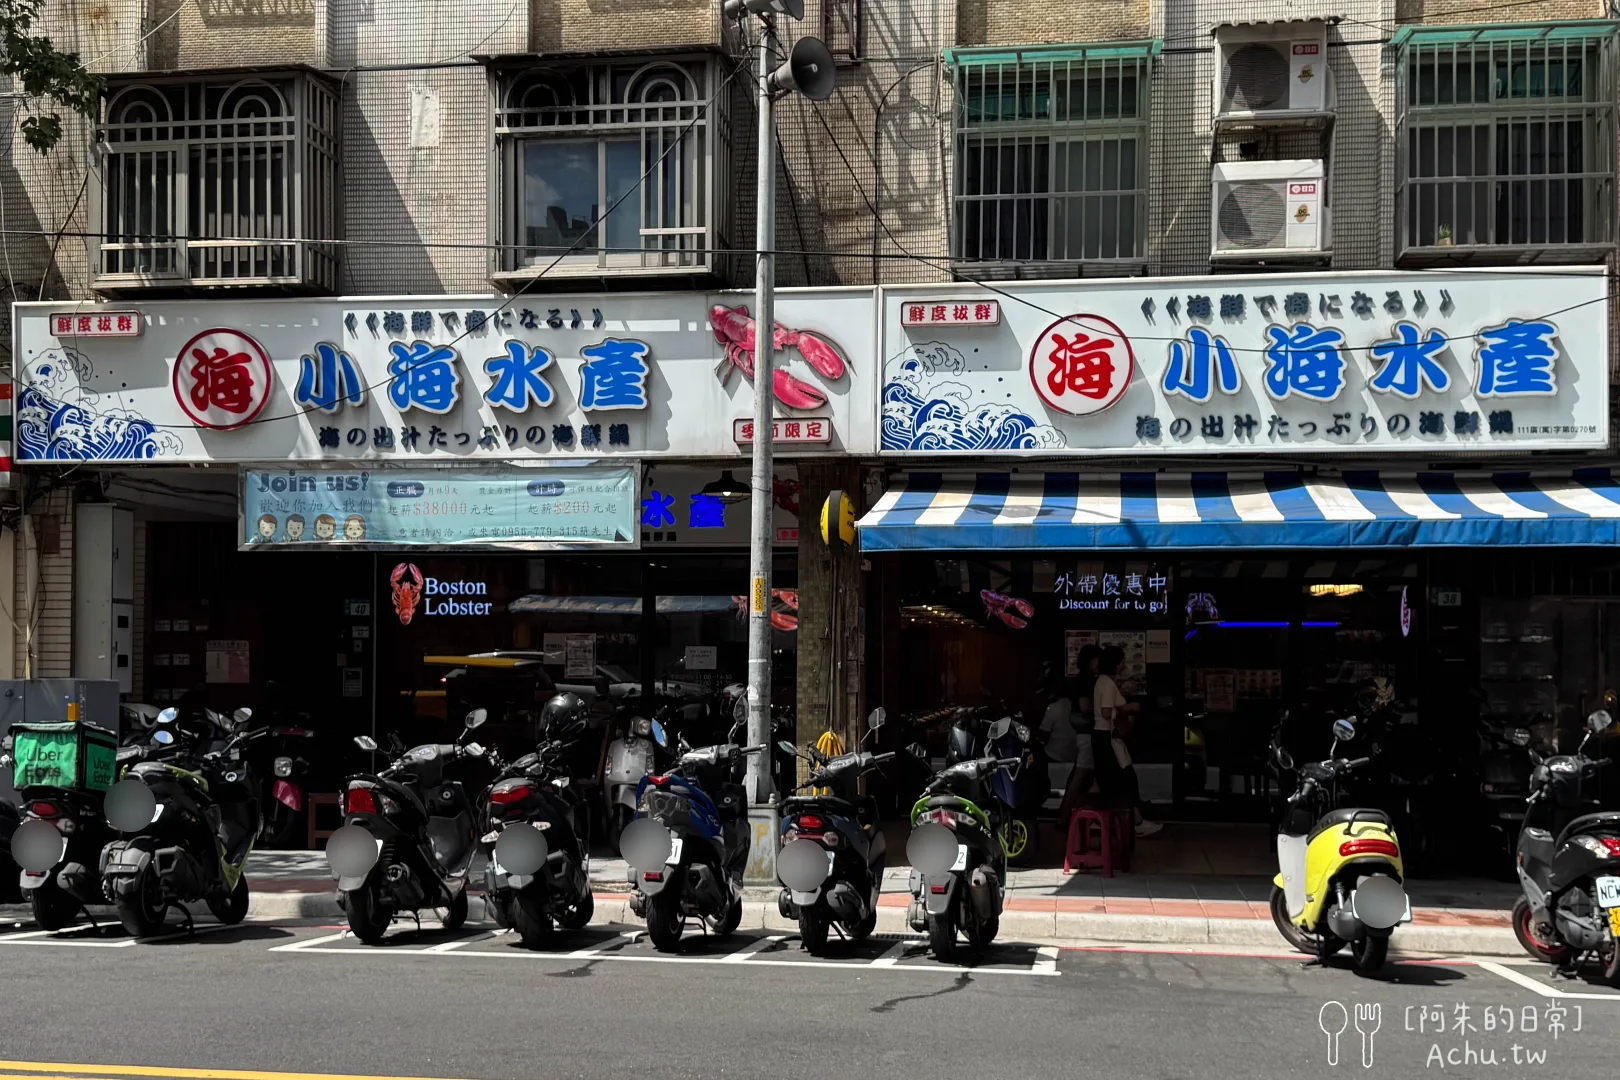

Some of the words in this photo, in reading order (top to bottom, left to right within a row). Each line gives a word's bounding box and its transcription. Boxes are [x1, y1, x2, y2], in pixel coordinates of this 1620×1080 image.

[1047, 333, 1116, 399] 海
[190, 347, 254, 414] 海
[257, 469, 317, 493] Join
[326, 471, 370, 492] us!
[260, 498, 373, 514] 歡迎你加入我們
[424, 577, 487, 596] Boston
[1053, 572, 1166, 596] 外帶優惠中
[424, 598, 493, 616] Lobster
[1059, 599, 1110, 610] Discount
[1114, 598, 1131, 609] for
[1134, 600, 1146, 610] to
[1443, 593, 1457, 604] 38
[355, 604, 366, 614] 40
[26, 747, 63, 762] Uber
[93, 757, 111, 770] Uber
